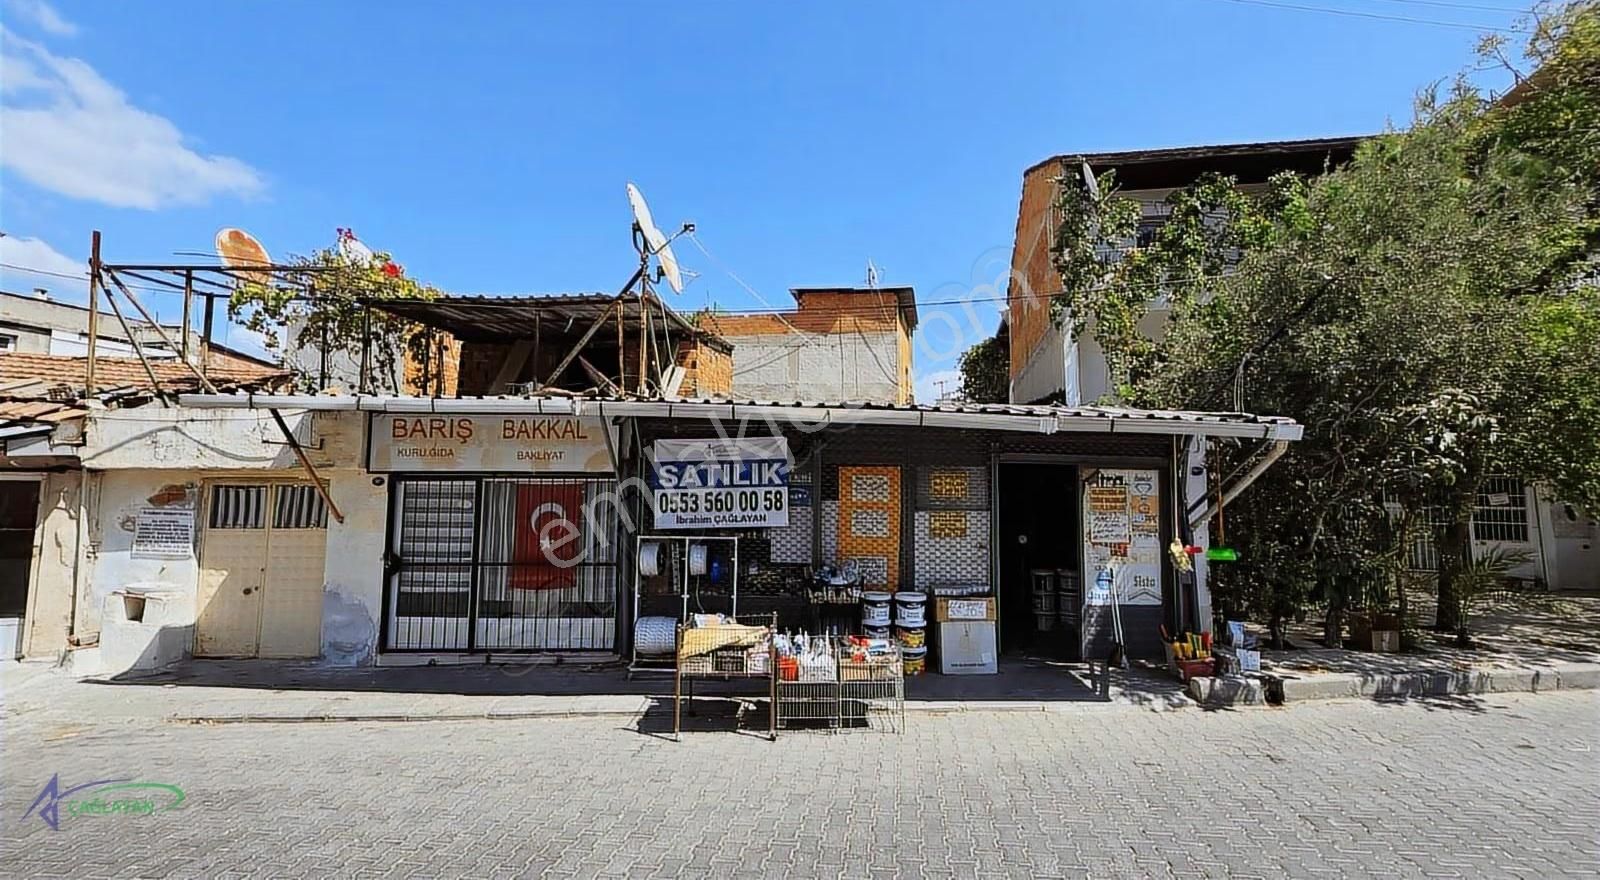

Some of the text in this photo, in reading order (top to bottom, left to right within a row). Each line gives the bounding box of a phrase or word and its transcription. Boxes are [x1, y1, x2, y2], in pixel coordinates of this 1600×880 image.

[392, 418, 588, 443] BARIŞ BAKKAL
[658, 462, 784, 489] SATILIK
[659, 490, 783, 513] 0553 560 00 58
